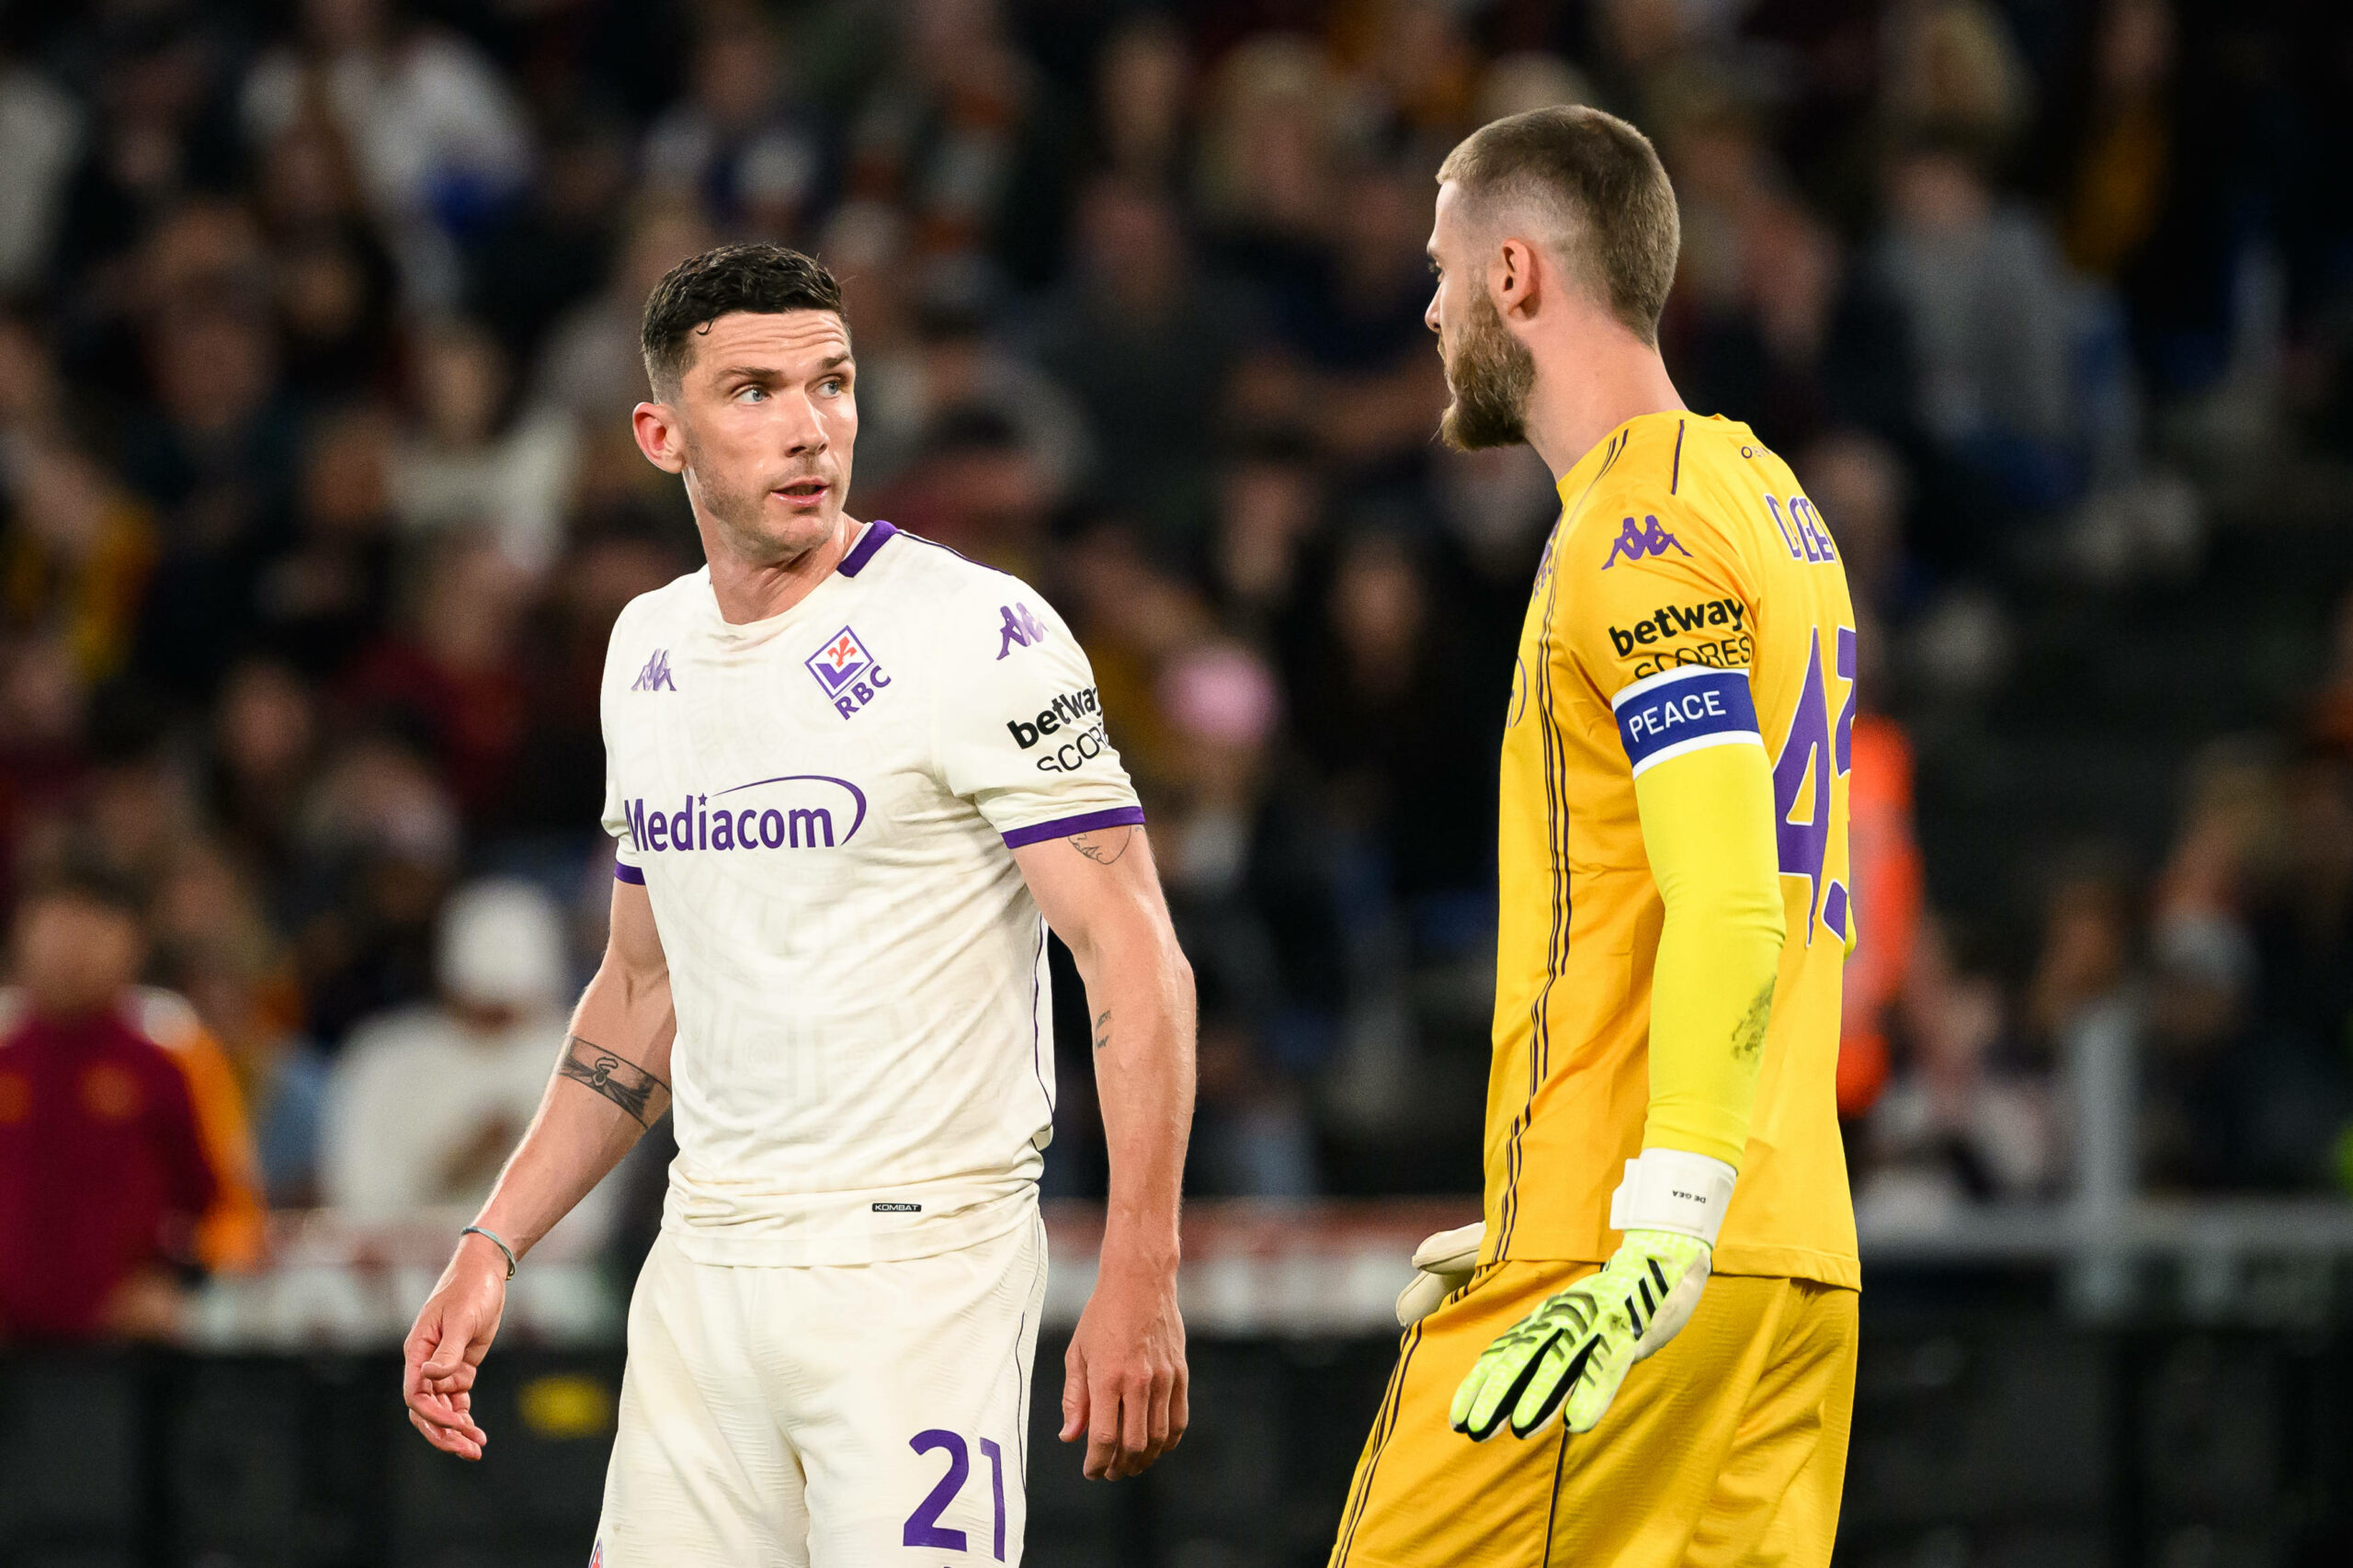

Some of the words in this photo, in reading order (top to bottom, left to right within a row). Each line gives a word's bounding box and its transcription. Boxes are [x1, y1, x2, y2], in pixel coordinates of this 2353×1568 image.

[1608, 598, 1744, 657] betway
[835, 665, 892, 721] RBC
[1629, 690, 1726, 743] PEACE
[1037, 726, 1108, 772] SCOR
[624, 792, 835, 851] Mediacom
[1672, 1189, 1691, 1199] GEA
[1694, 1195, 1706, 1204] DE
[903, 1429, 1006, 1562] 21
